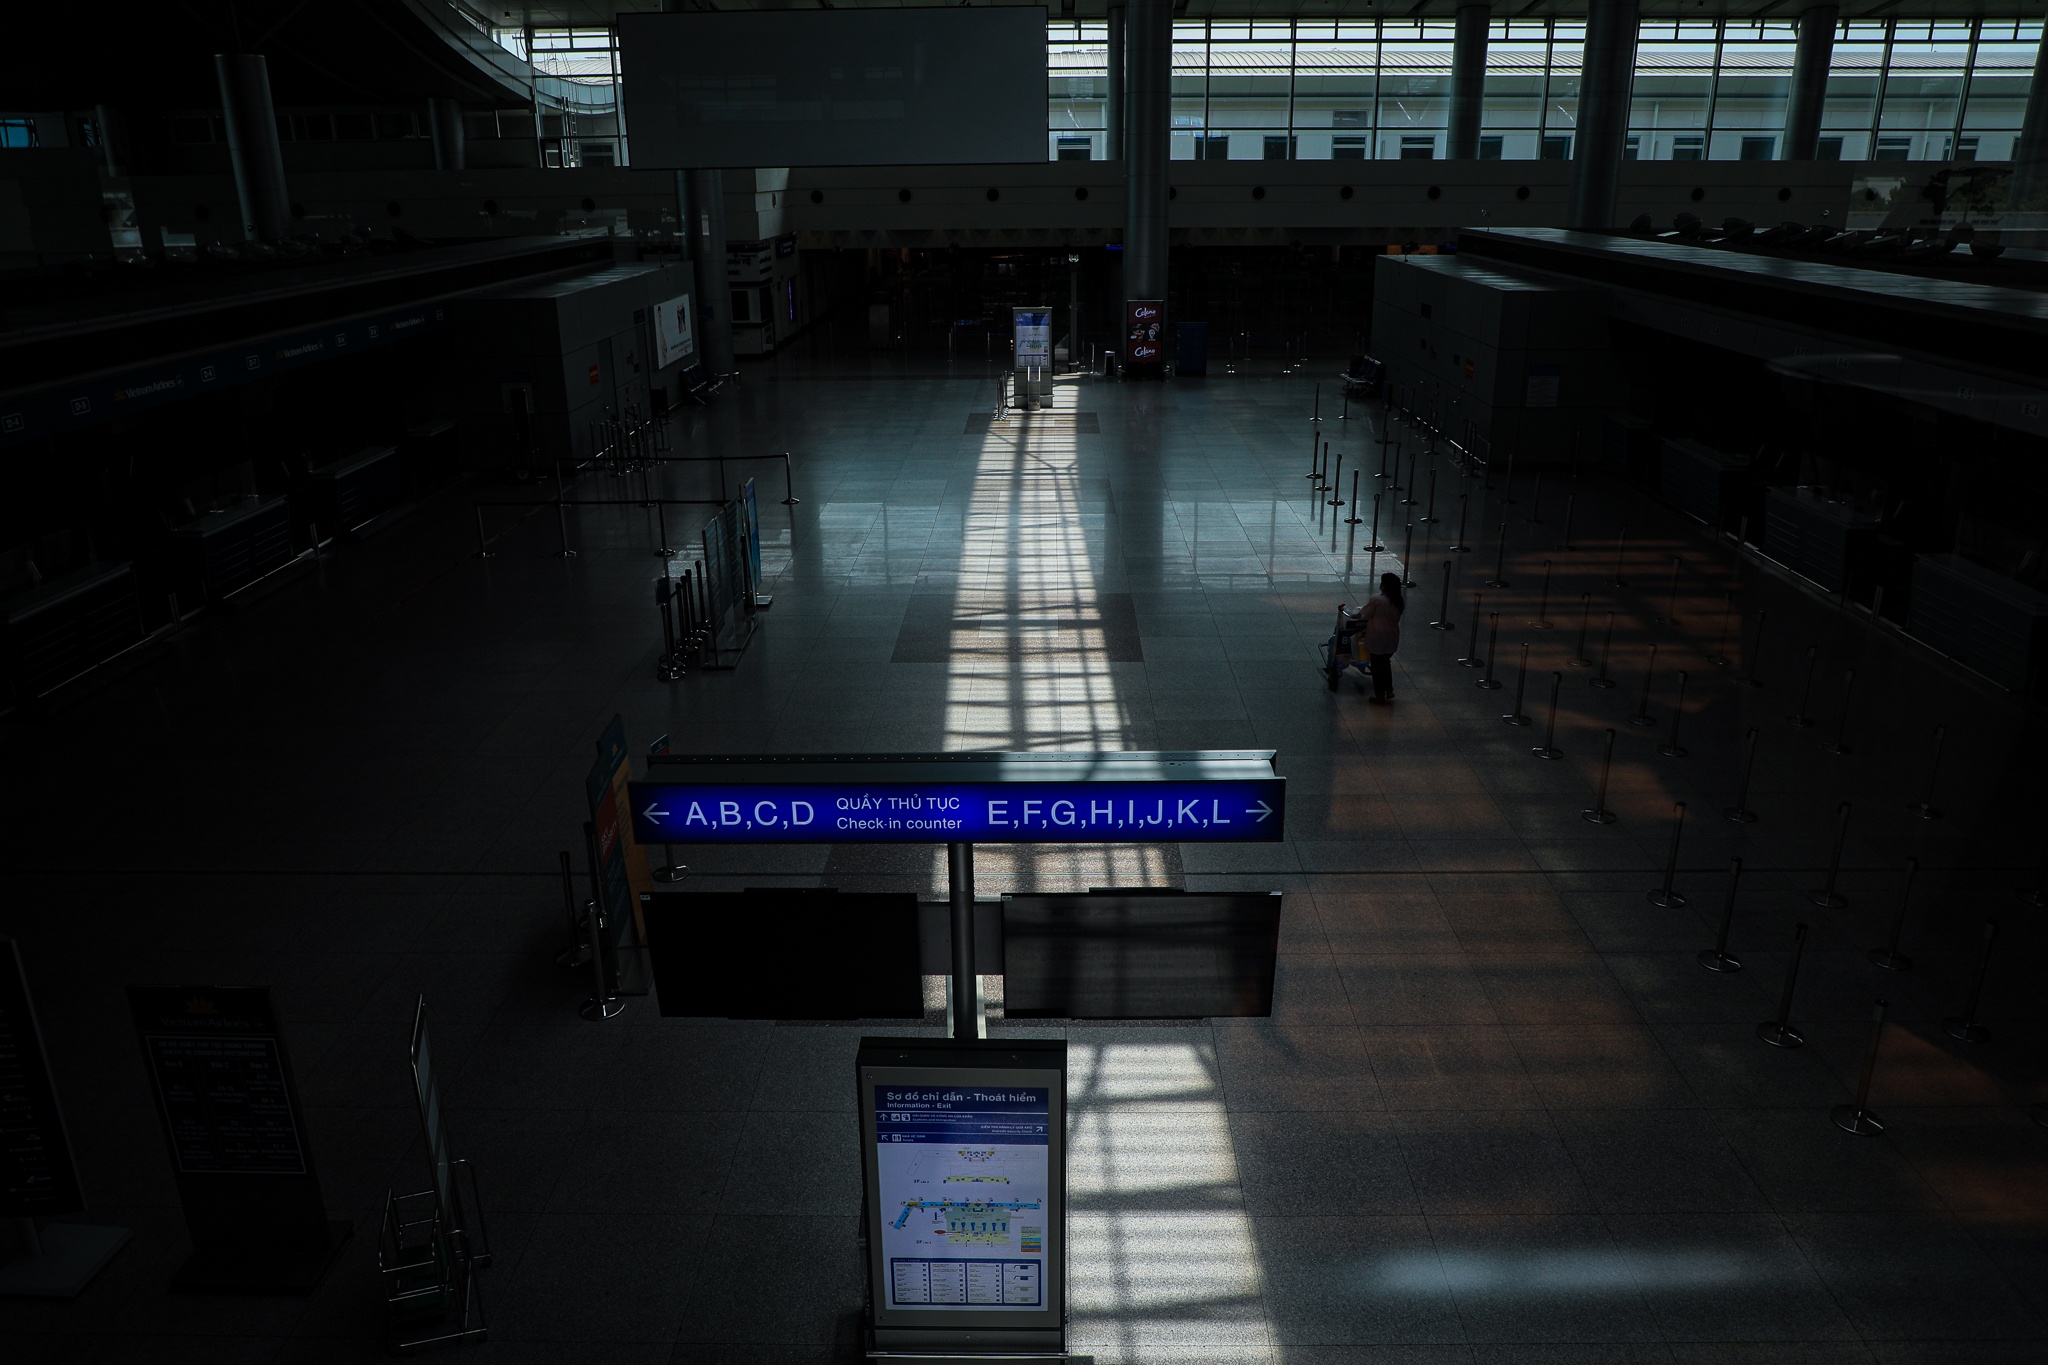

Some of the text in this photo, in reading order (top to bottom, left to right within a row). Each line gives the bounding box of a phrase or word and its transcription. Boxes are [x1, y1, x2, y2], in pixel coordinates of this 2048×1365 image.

[836, 792, 960, 812] QUẦY THỦ TỤC
[685, 800, 815, 831] A,B,C,D
[987, 799, 1231, 829] E,F,G,H,I,J,K,L
[836, 816, 962, 829] Check-in counter
[886, 1091, 903, 1101] Sơ
[905, 1091, 919, 1101] đồ
[922, 1091, 940, 1102] chỉ
[942, 1091, 964, 1102] dẫn
[973, 1092, 1006, 1102] Thoát
[1009, 1092, 1037, 1103] hiểm
[936, 1102, 952, 1110] Exit
